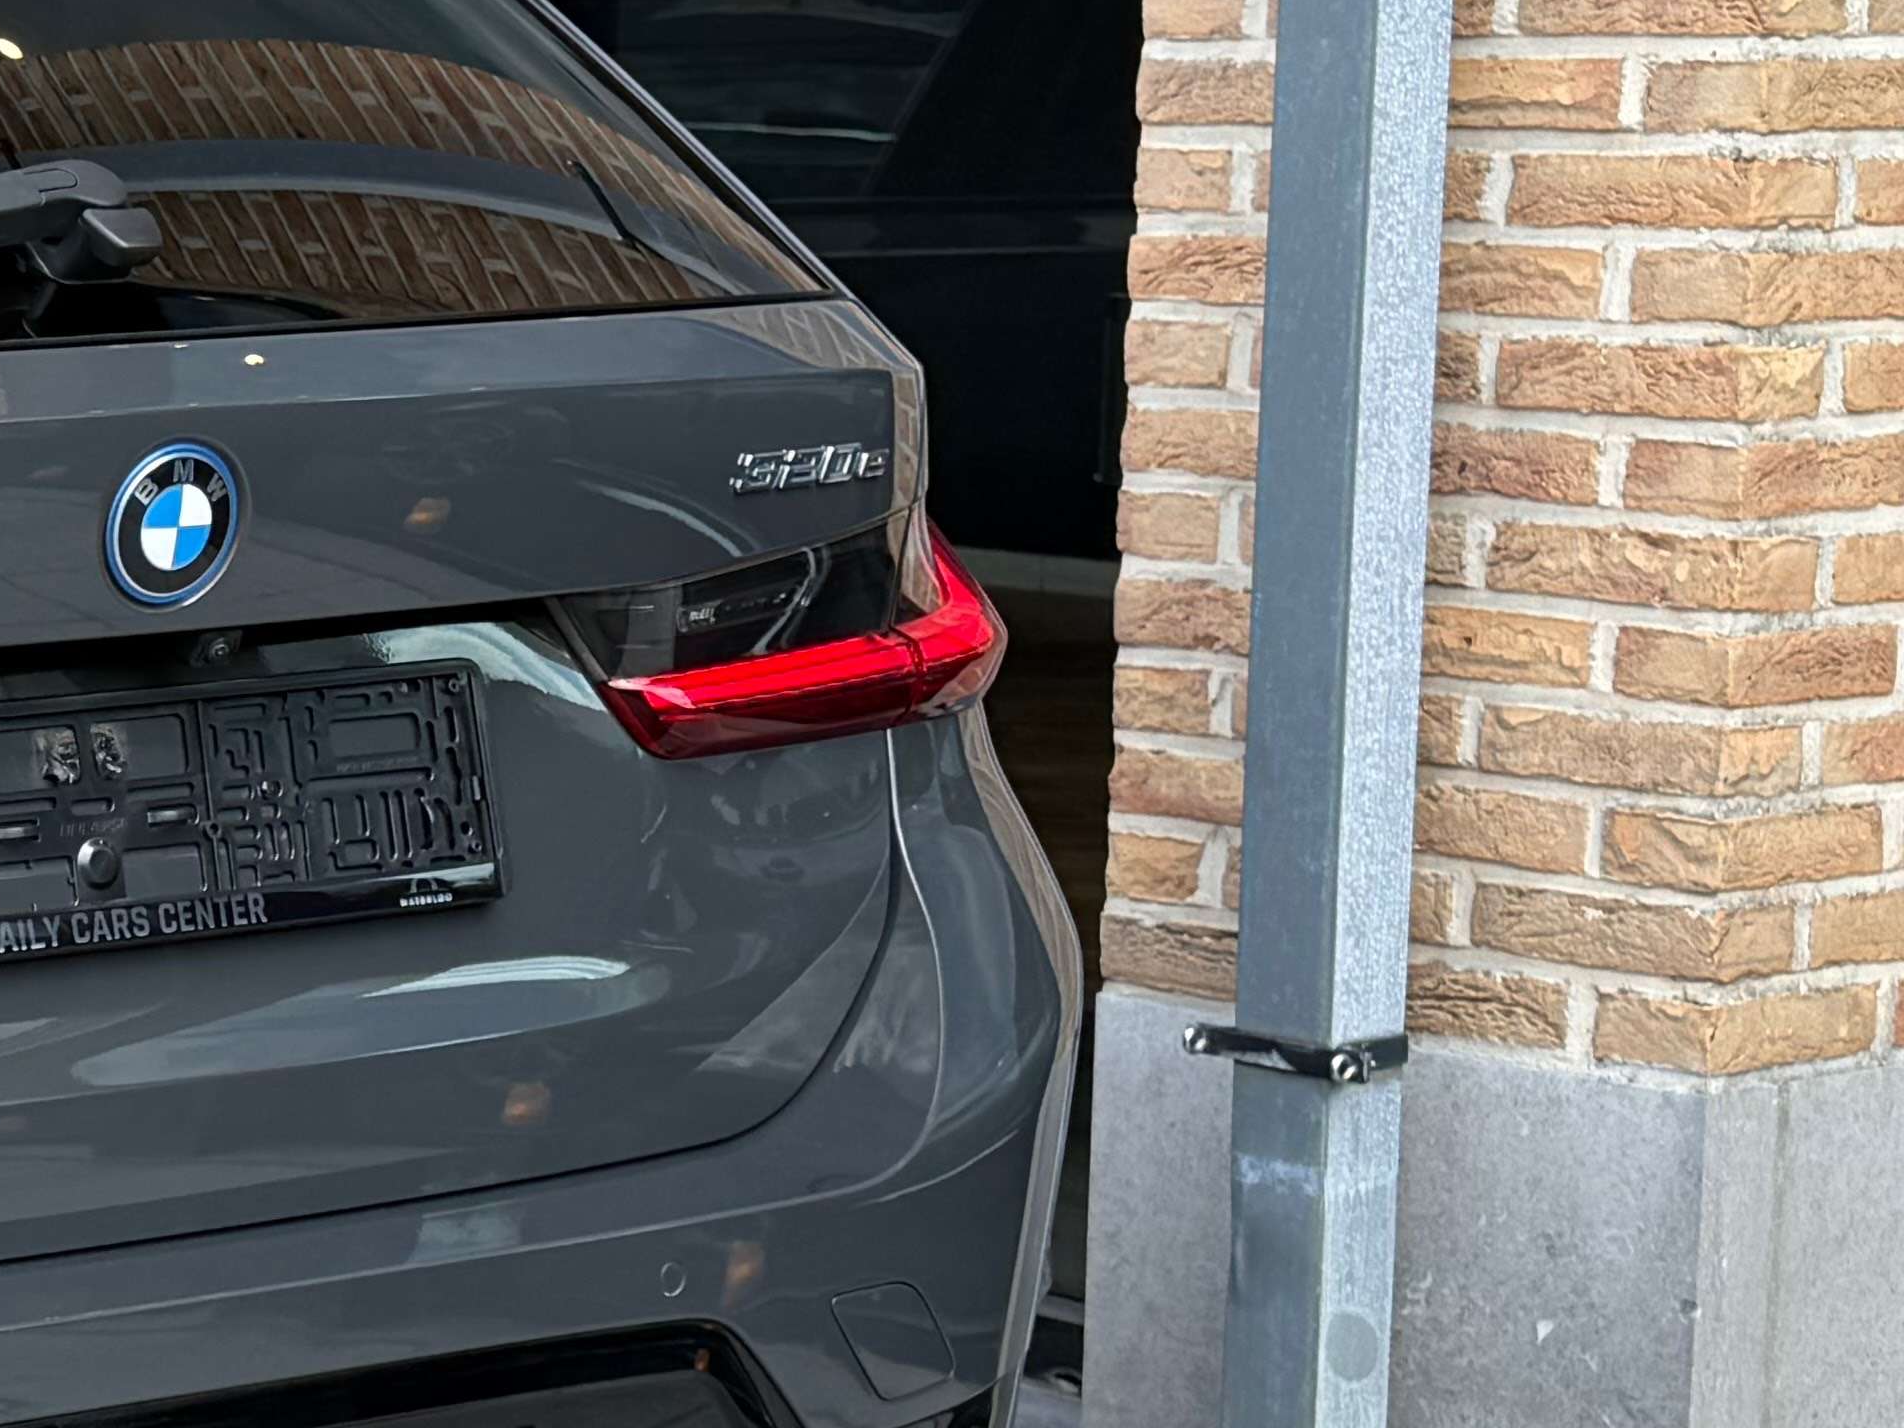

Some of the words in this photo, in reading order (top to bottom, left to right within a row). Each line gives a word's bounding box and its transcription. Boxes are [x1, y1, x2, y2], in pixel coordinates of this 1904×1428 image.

[134, 458, 228, 506] BMW
[72, 904, 151, 945] CARS
[159, 892, 269, 934] CENTER
